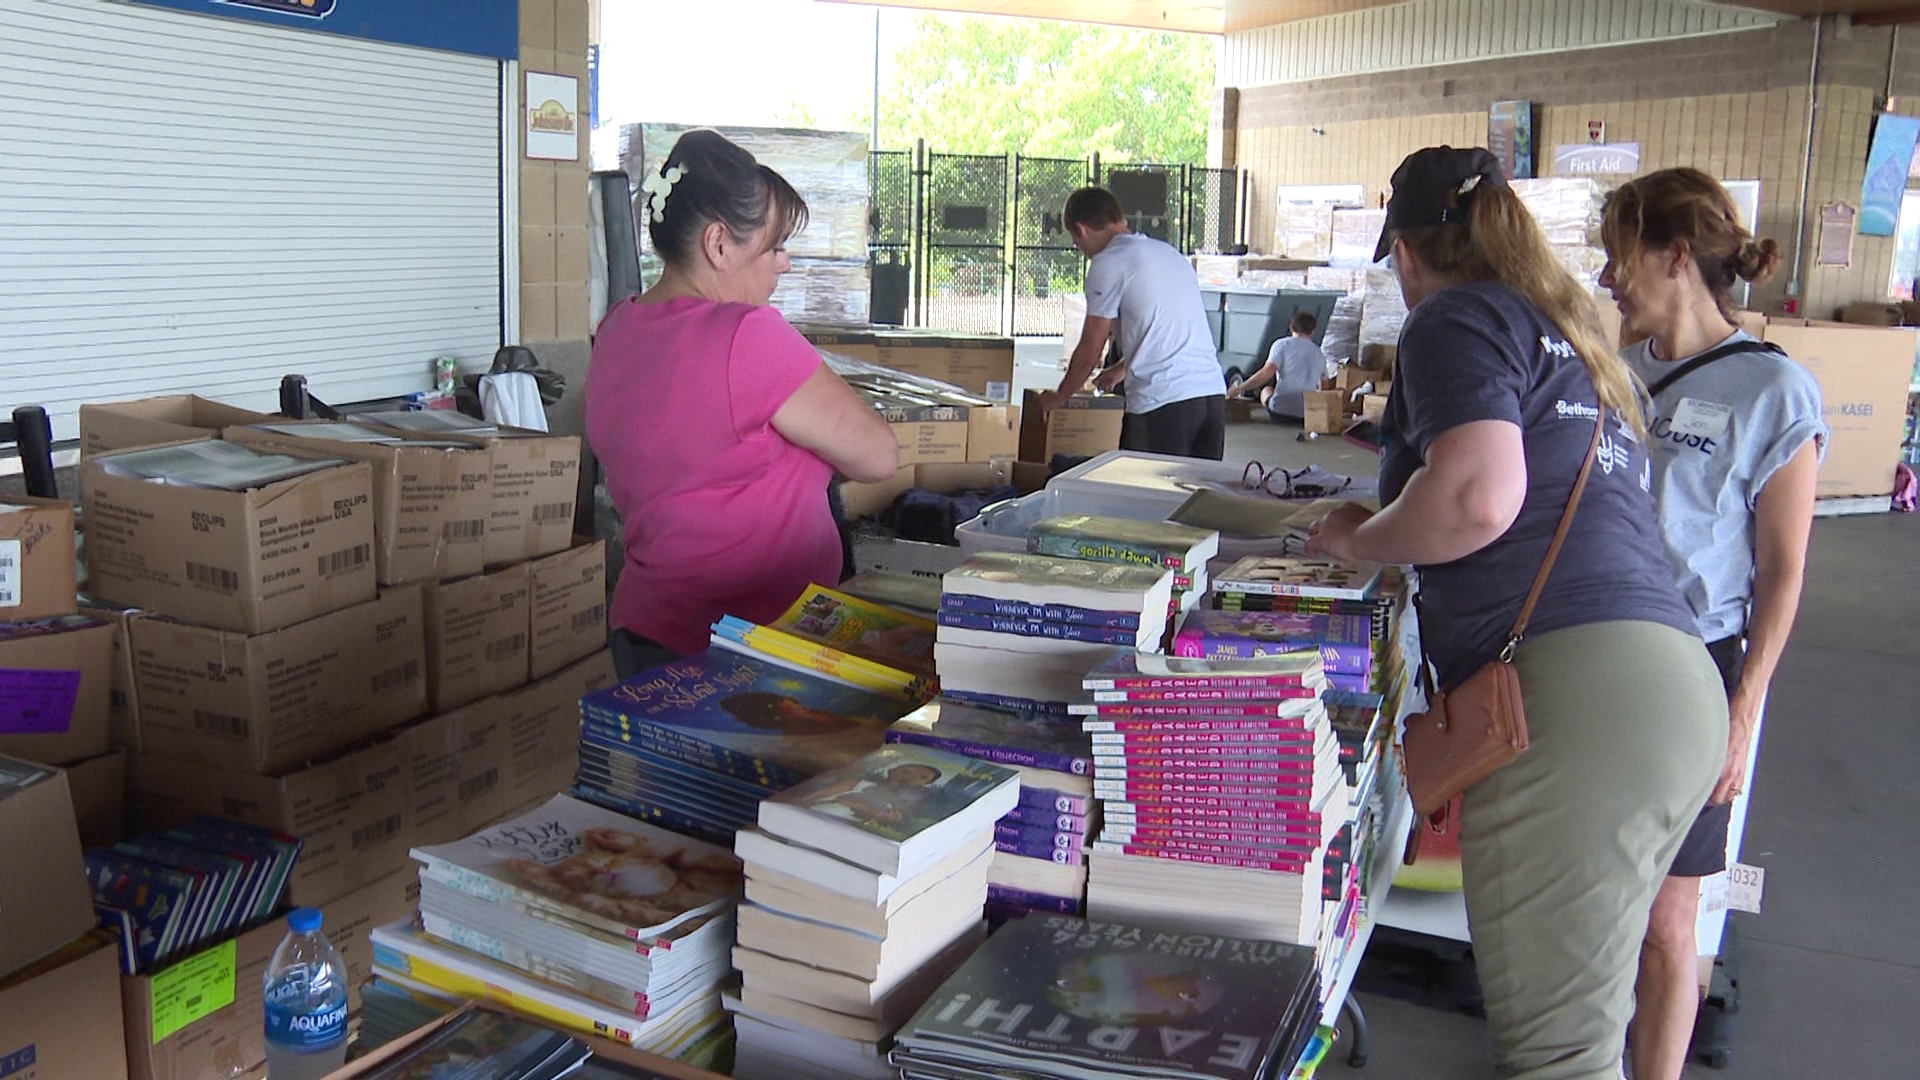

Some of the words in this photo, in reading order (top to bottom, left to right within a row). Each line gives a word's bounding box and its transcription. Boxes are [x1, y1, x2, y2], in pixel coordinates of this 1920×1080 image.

[1570, 157, 1596, 172] First
[1599, 156, 1621, 172] Aid
[1558, 400, 1598, 416] Bethan
[334, 494, 367, 510] ECLIPS
[334, 508, 352, 519] USA
[1080, 543, 1116, 558] gorilla
[1120, 547, 1151, 565] dawn
[1271, 585, 1300, 595] COLORS
[1044, 607, 1063, 620] WITH
[1065, 607, 1084, 622] You
[1042, 624, 1060, 636] WITH
[1062, 623, 1081, 638] You
[1215, 645, 1238, 655] JAMES
[1210, 678, 1235, 686] BETHANY
[1238, 677, 1267, 686] HAMILTON
[614, 676, 675, 703] Long
[1224, 690, 1249, 698] BETHANY
[1252, 689, 1281, 698] HAMILTON
[1212, 721, 1237, 730] BETHANY
[1239, 721, 1269, 730] HAMILTON
[1222, 733, 1248, 742] BETHANY
[1251, 733, 1279, 741] HAMILTON
[992, 750, 1035, 763] COLLECTION
[1221, 746, 1247, 755] BETHANY
[1249, 746, 1278, 755] HAMILTON
[1222, 760, 1247, 769] BETHANY
[1250, 761, 1279, 770] HAMILTON
[1222, 773, 1247, 782] BETHANY
[1249, 774, 1278, 783] HAMILTON
[1221, 785, 1246, 794] BETHANY
[1248, 786, 1277, 795] HAMILTON
[1220, 798, 1245, 807] BETHANY
[1247, 800, 1275, 809] HAMILTON
[1231, 809, 1256, 819] BETHANY
[1258, 811, 1287, 820] HAMILTON
[1231, 821, 1256, 831] BETHANY
[1258, 823, 1287, 832] HAMILTON
[1231, 833, 1256, 843] BETHANY
[1258, 835, 1287, 845] HAMILTON
[1223, 846, 1248, 855] BETHANY
[1250, 849, 1278, 858] HAMILTON
[1216, 856, 1241, 865] BETHANY
[1242, 858, 1271, 869] HAMILTON
[1044, 916, 1142, 941] YEARS
[1153, 931, 1295, 958] BILLION
[1228, 951, 1278, 966] MY
[932, 991, 1262, 1070] EARTH!
